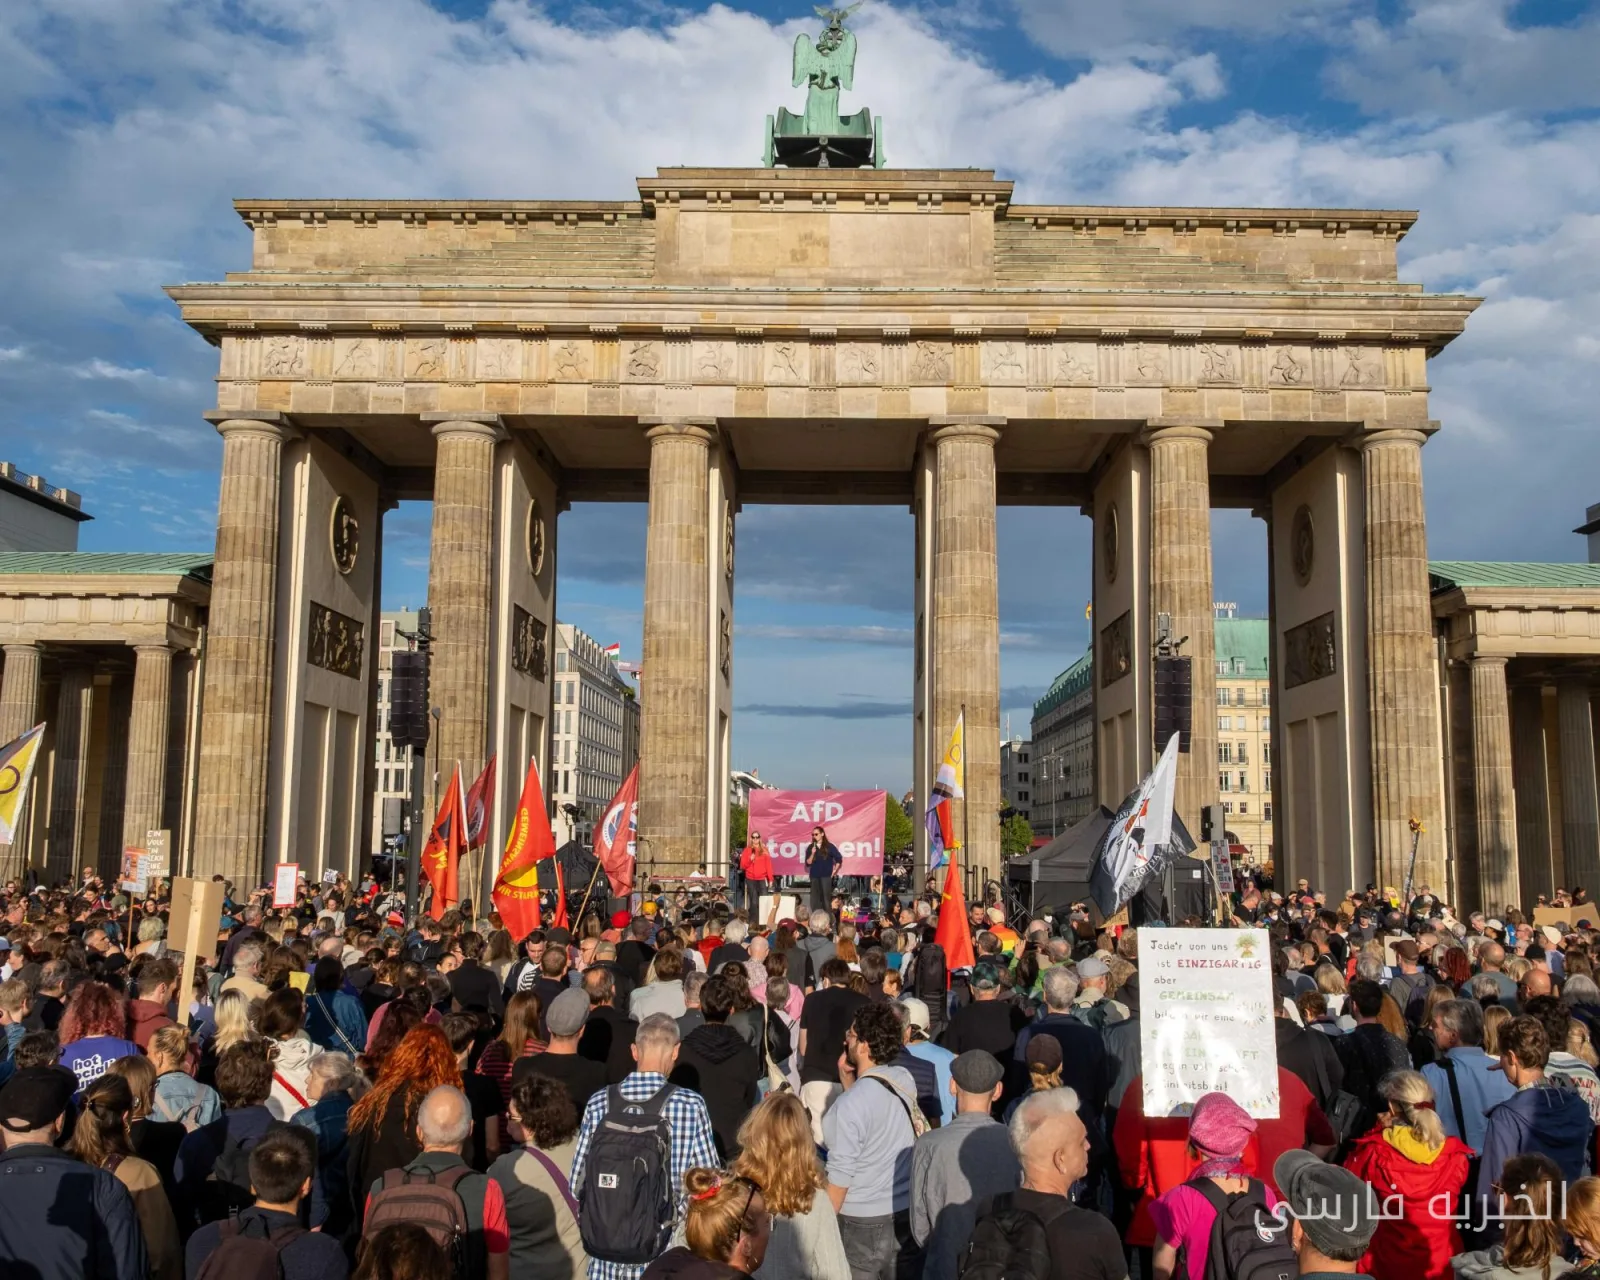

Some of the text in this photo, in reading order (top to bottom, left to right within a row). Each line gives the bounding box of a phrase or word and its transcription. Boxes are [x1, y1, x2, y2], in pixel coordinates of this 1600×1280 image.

[789, 800, 844, 823] AfD
[766, 837, 880, 864] topen!
[1189, 943, 1206, 951] von
[1211, 943, 1229, 951] uns
[1153, 975, 1177, 985] aber
[74, 1055, 100, 1071] hot
